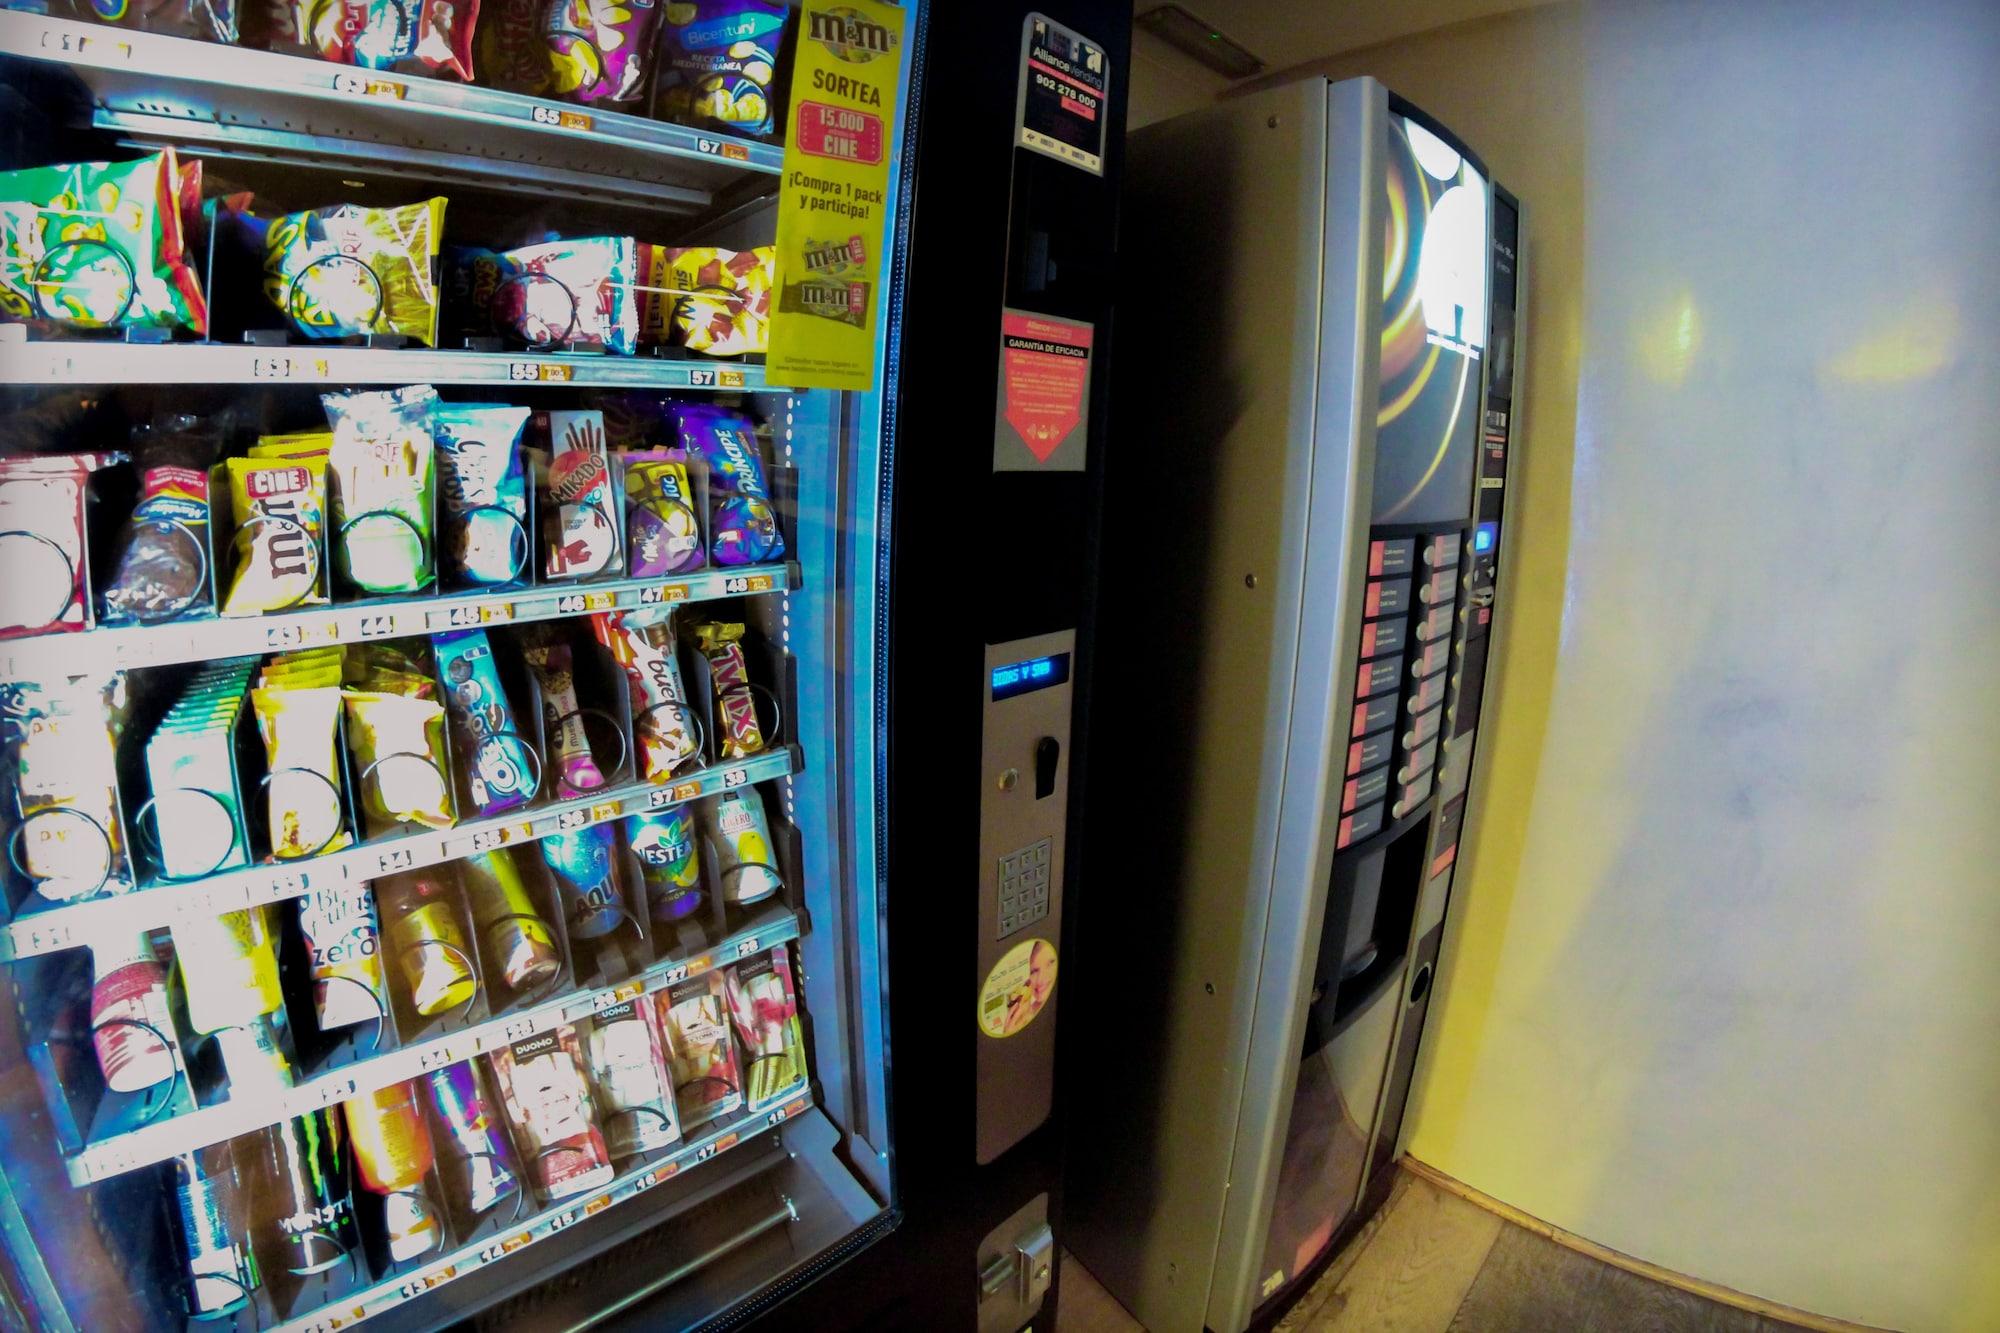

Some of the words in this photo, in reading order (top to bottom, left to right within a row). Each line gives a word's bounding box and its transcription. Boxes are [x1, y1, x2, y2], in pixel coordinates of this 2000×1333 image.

[812, 68, 881, 108] SORTEA
[1035, 74, 1056, 91] 902
[1078, 94, 1097, 109] 000
[533, 106, 561, 125] 65
[819, 108, 865, 132] 15.000
[698, 139, 721, 154] 67
[823, 135, 859, 159] CINE
[788, 172, 842, 195] ¡Compra
[846, 183, 852, 196] 1
[854, 187, 882, 205] pack
[799, 195, 809, 210] y
[810, 196, 870, 219] participa!
[1008, 338, 1045, 352] GARANTÍA
[1045, 344, 1054, 353] DE
[1055, 345, 1085, 358] EFICACIA
[691, 370, 715, 385] 57
[255, 468, 301, 494] CINE
[551, 453, 605, 504] MIKADO
[640, 588, 664, 604] 47
[726, 578, 748, 594] 48
[710, 643, 758, 739] TWIX
[650, 789, 674, 806] 37
[637, 840, 692, 864] NESTEA
[312, 936, 377, 967] zero
[665, 965, 688, 984] 27
[597, 1004, 631, 1019] UOMO
[515, 1036, 554, 1056] DUOMO
[697, 1144, 719, 1163] 17
[480, 1243, 505, 1263] 14
